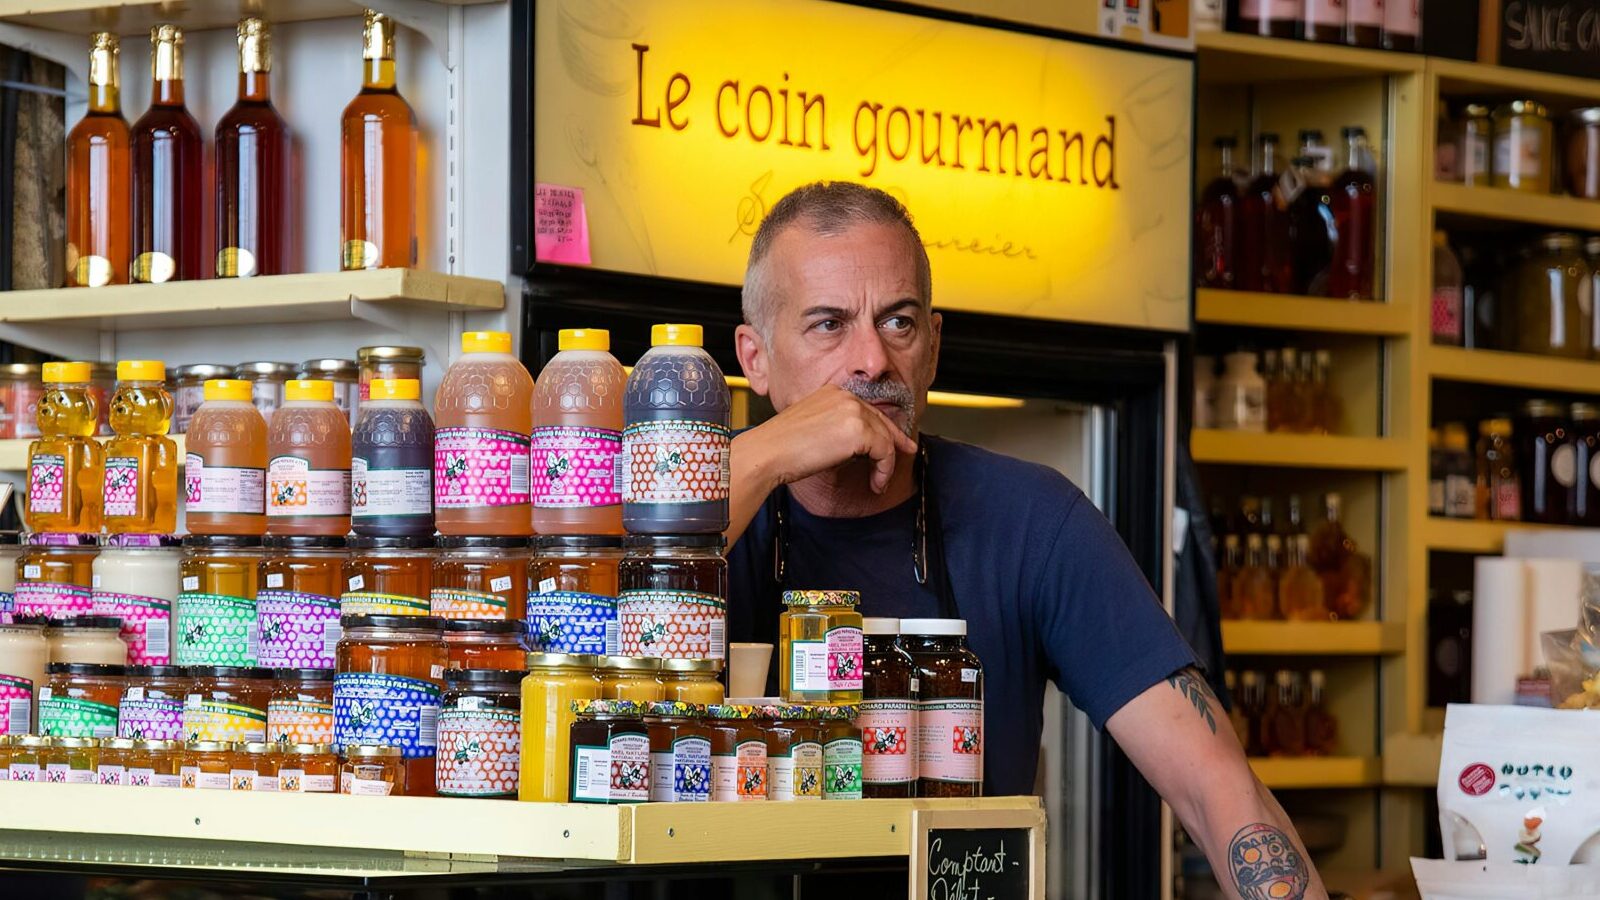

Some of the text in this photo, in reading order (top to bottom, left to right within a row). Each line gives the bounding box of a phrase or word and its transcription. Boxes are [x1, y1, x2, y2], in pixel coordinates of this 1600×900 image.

[631, 43, 1121, 190] Le coin gourmand
[929, 838, 1006, 890] Comptant
